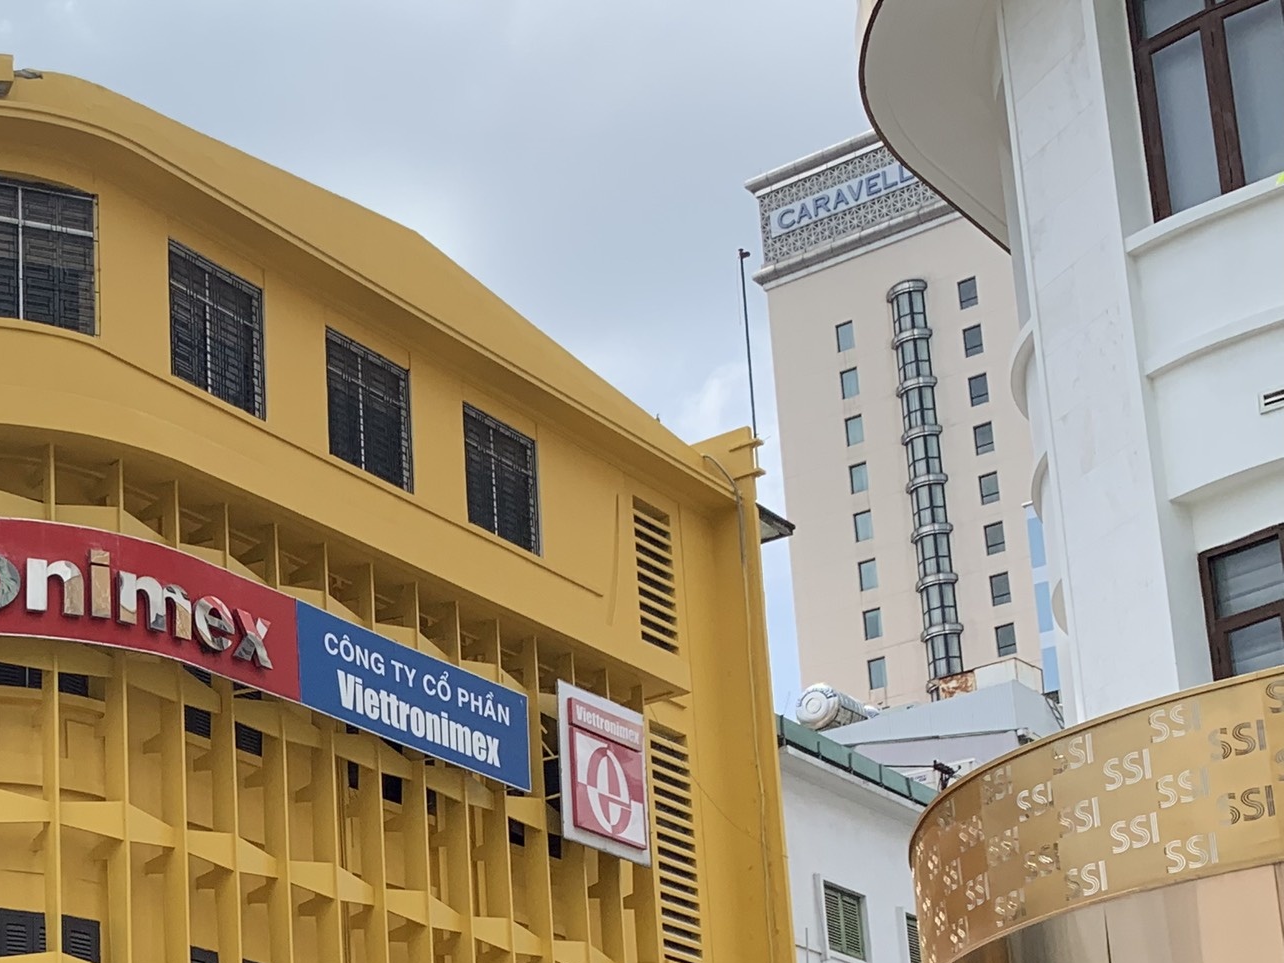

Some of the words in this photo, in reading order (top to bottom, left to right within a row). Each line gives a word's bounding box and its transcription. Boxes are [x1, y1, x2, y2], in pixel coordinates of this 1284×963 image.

[776, 164, 915, 230] CARAVELL
[324, 632, 385, 677] CÔNG
[391, 659, 416, 688] TY
[422, 671, 452, 702] CỔ
[457, 690, 511, 726] PHẦN
[336, 669, 501, 769] Viettronimex
[575, 704, 641, 745] Viettronimex
[1148, 700, 1201, 744] SSI
[1208, 719, 1266, 762] SSI
[1103, 748, 1153, 791] SSI
[1156, 767, 1210, 809] SSI
[1017, 780, 1054, 823] SSI
[1058, 796, 1102, 839] SSI
[1217, 785, 1276, 827] SSI
[1110, 811, 1160, 855] SSI
[1164, 832, 1219, 874] SSI
[1065, 860, 1109, 901] SSI
